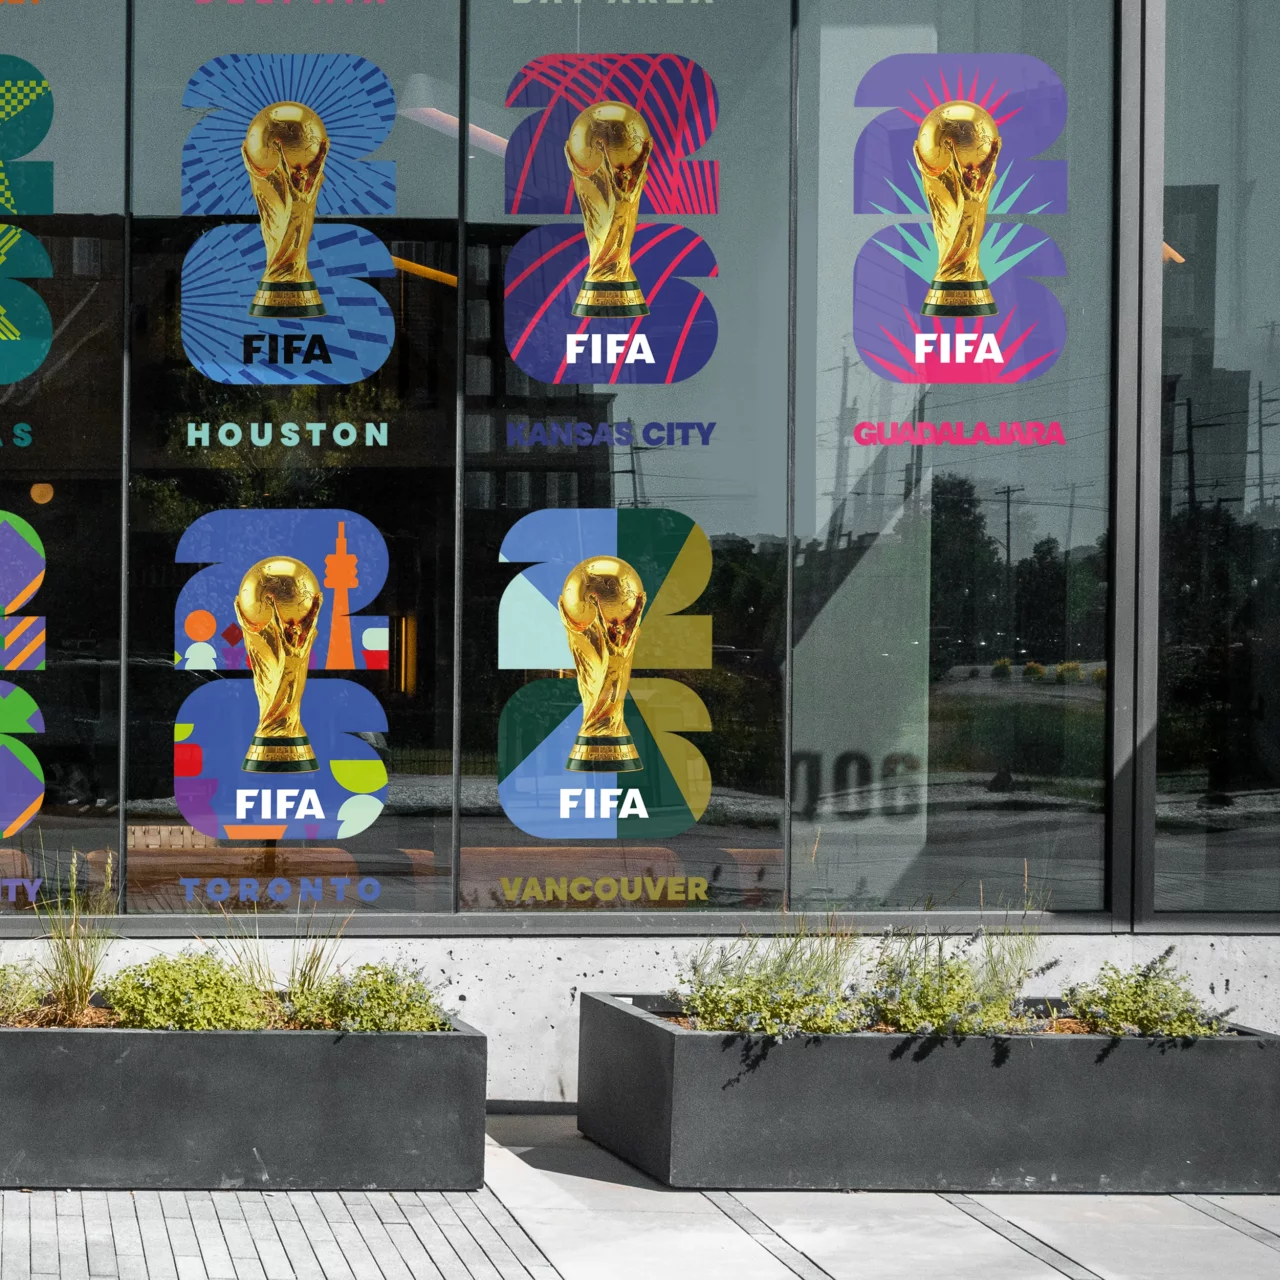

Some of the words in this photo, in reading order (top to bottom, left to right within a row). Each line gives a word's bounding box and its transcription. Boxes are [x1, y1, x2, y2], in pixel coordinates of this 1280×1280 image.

[243, 333, 332, 364] FIFA
[566, 333, 655, 364] FIFA
[915, 333, 1004, 364] FIFA
[188, 422, 388, 447] HOUSTON
[507, 422, 634, 447] KANSAS
[642, 422, 717, 447] CITY
[853, 421, 1067, 446] GUADALAJARA
[235, 789, 325, 819] FIFA
[559, 788, 649, 819] FIFA
[179, 877, 382, 902] TORONTO
[499, 876, 709, 901] VANCOUVER
